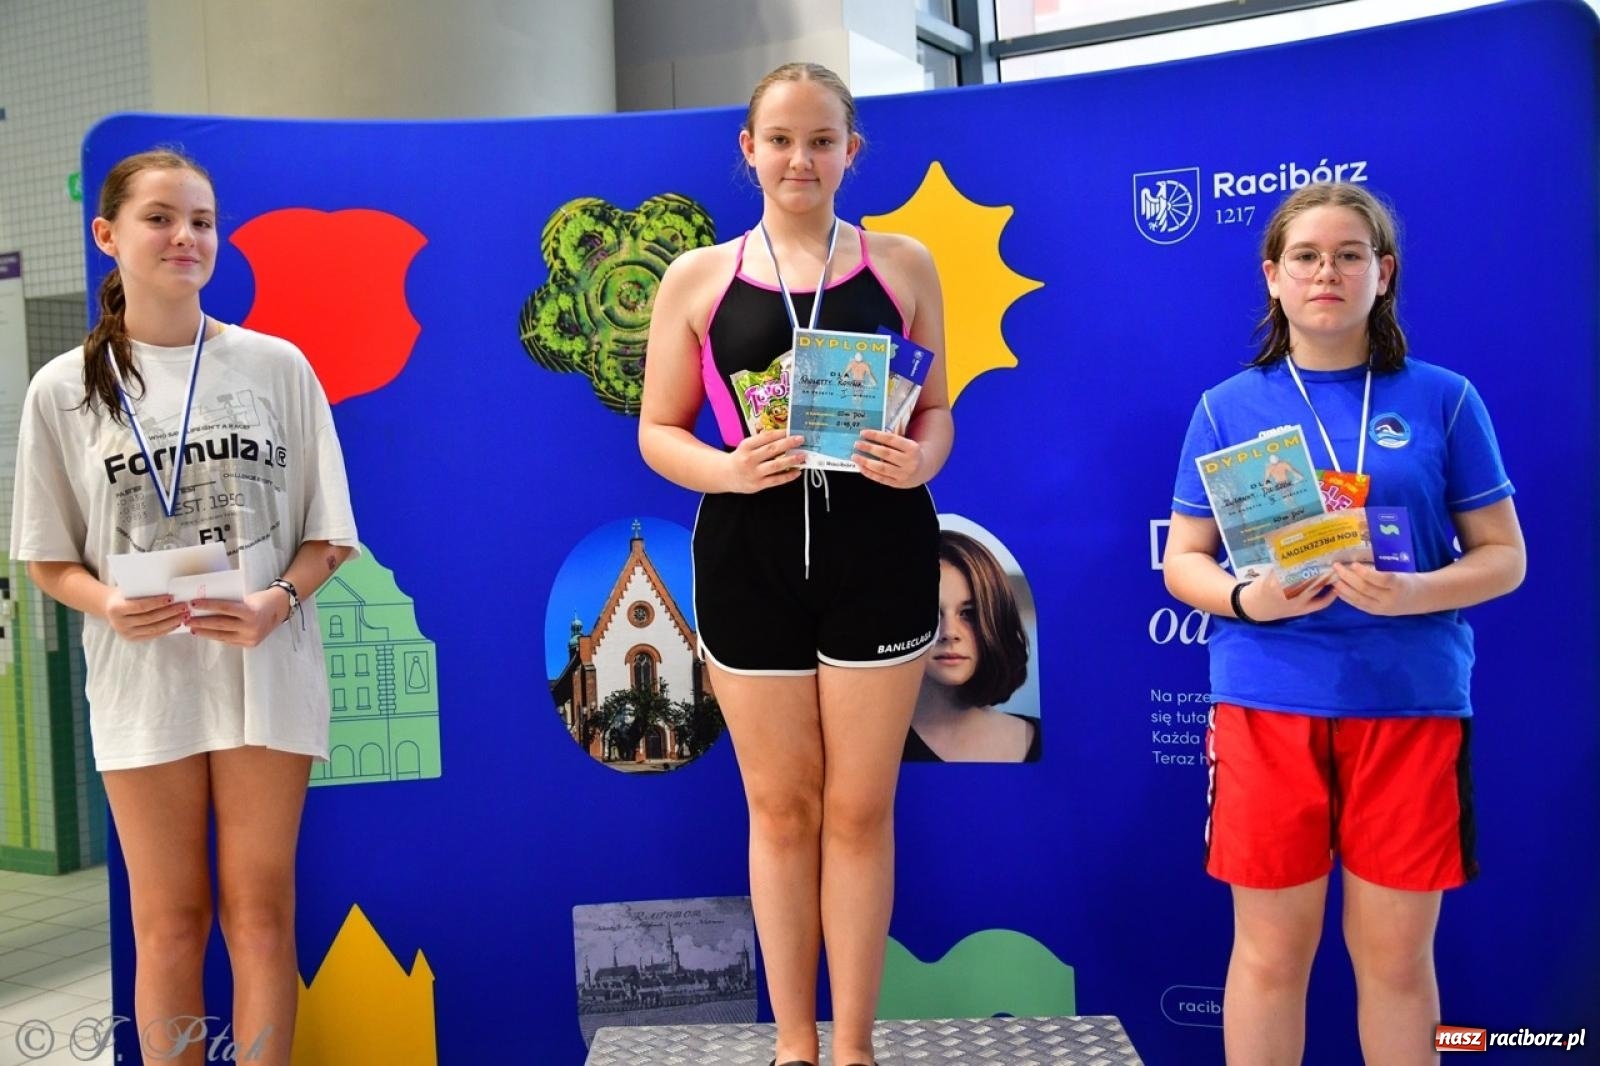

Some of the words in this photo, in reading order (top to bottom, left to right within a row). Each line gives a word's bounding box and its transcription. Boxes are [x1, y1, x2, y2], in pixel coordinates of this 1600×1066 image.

[1213, 158, 1368, 199] Racibórz
[1215, 206, 1256, 226] 1217
[798, 335, 886, 353] DYPLOM
[104, 433, 259, 485] Formula
[1204, 434, 1301, 475] DYPLOM
[1337, 531, 1358, 541] BON
[1281, 536, 1336, 561] PREZENTOWY
[1150, 689, 1172, 702] Na
[1177, 692, 1211, 706] prze
[1151, 709, 1172, 726] się
[1151, 730, 1200, 744] Każda
[1151, 750, 1195, 765] Teraz
[1179, 1000, 1224, 1014] racib
